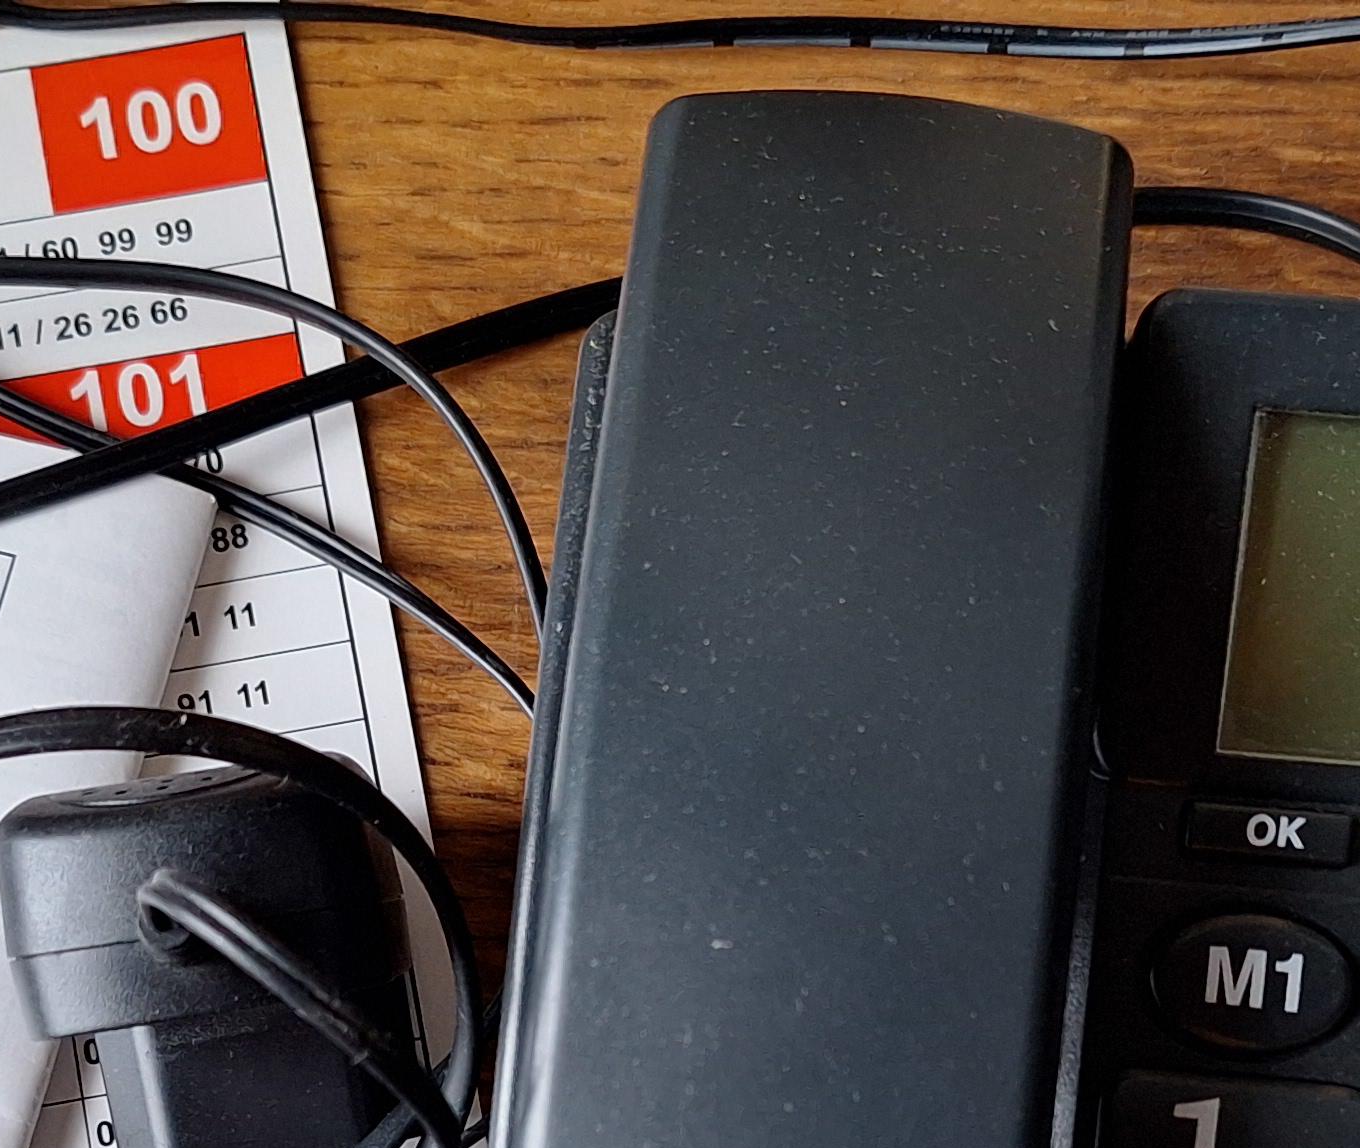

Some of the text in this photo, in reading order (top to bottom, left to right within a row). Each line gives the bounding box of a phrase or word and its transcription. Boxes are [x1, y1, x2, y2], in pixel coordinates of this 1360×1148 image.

[79, 82, 222, 160] 100
[99, 228, 136, 255] 99
[156, 218, 193, 246] 99
[54, 314, 93, 341] 26
[103, 306, 141, 333] 26
[150, 298, 188, 325] 66
[70, 353, 209, 432] 101
[211, 524, 249, 552] 88
[223, 602, 256, 630] 11
[237, 680, 270, 708] 11
[1246, 813, 1307, 850] OK
[1204, 945, 1305, 1013] M1
